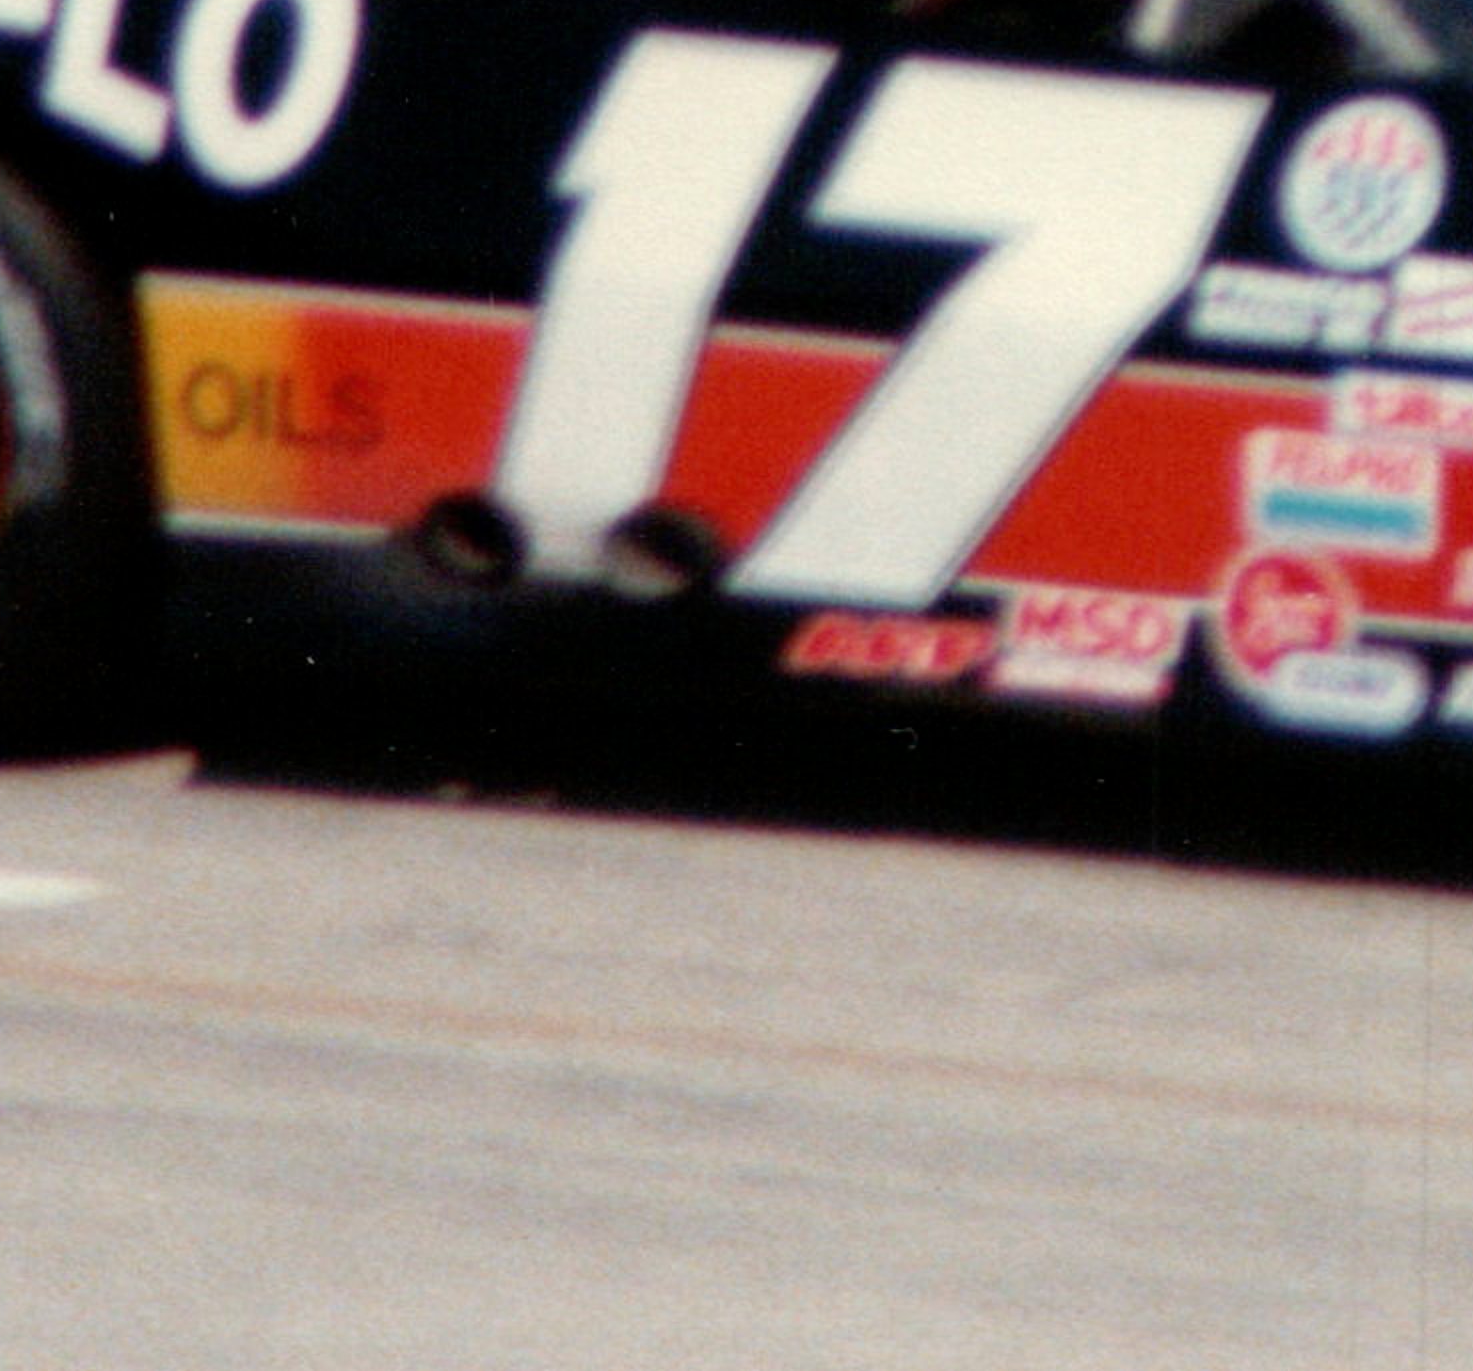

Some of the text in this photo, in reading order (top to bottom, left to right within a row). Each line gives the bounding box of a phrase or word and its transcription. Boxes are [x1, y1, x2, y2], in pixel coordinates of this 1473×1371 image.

[486, 25, 1276, 609] 17
[178, 357, 390, 452] OILS
[1016, 591, 1172, 661] MSD
